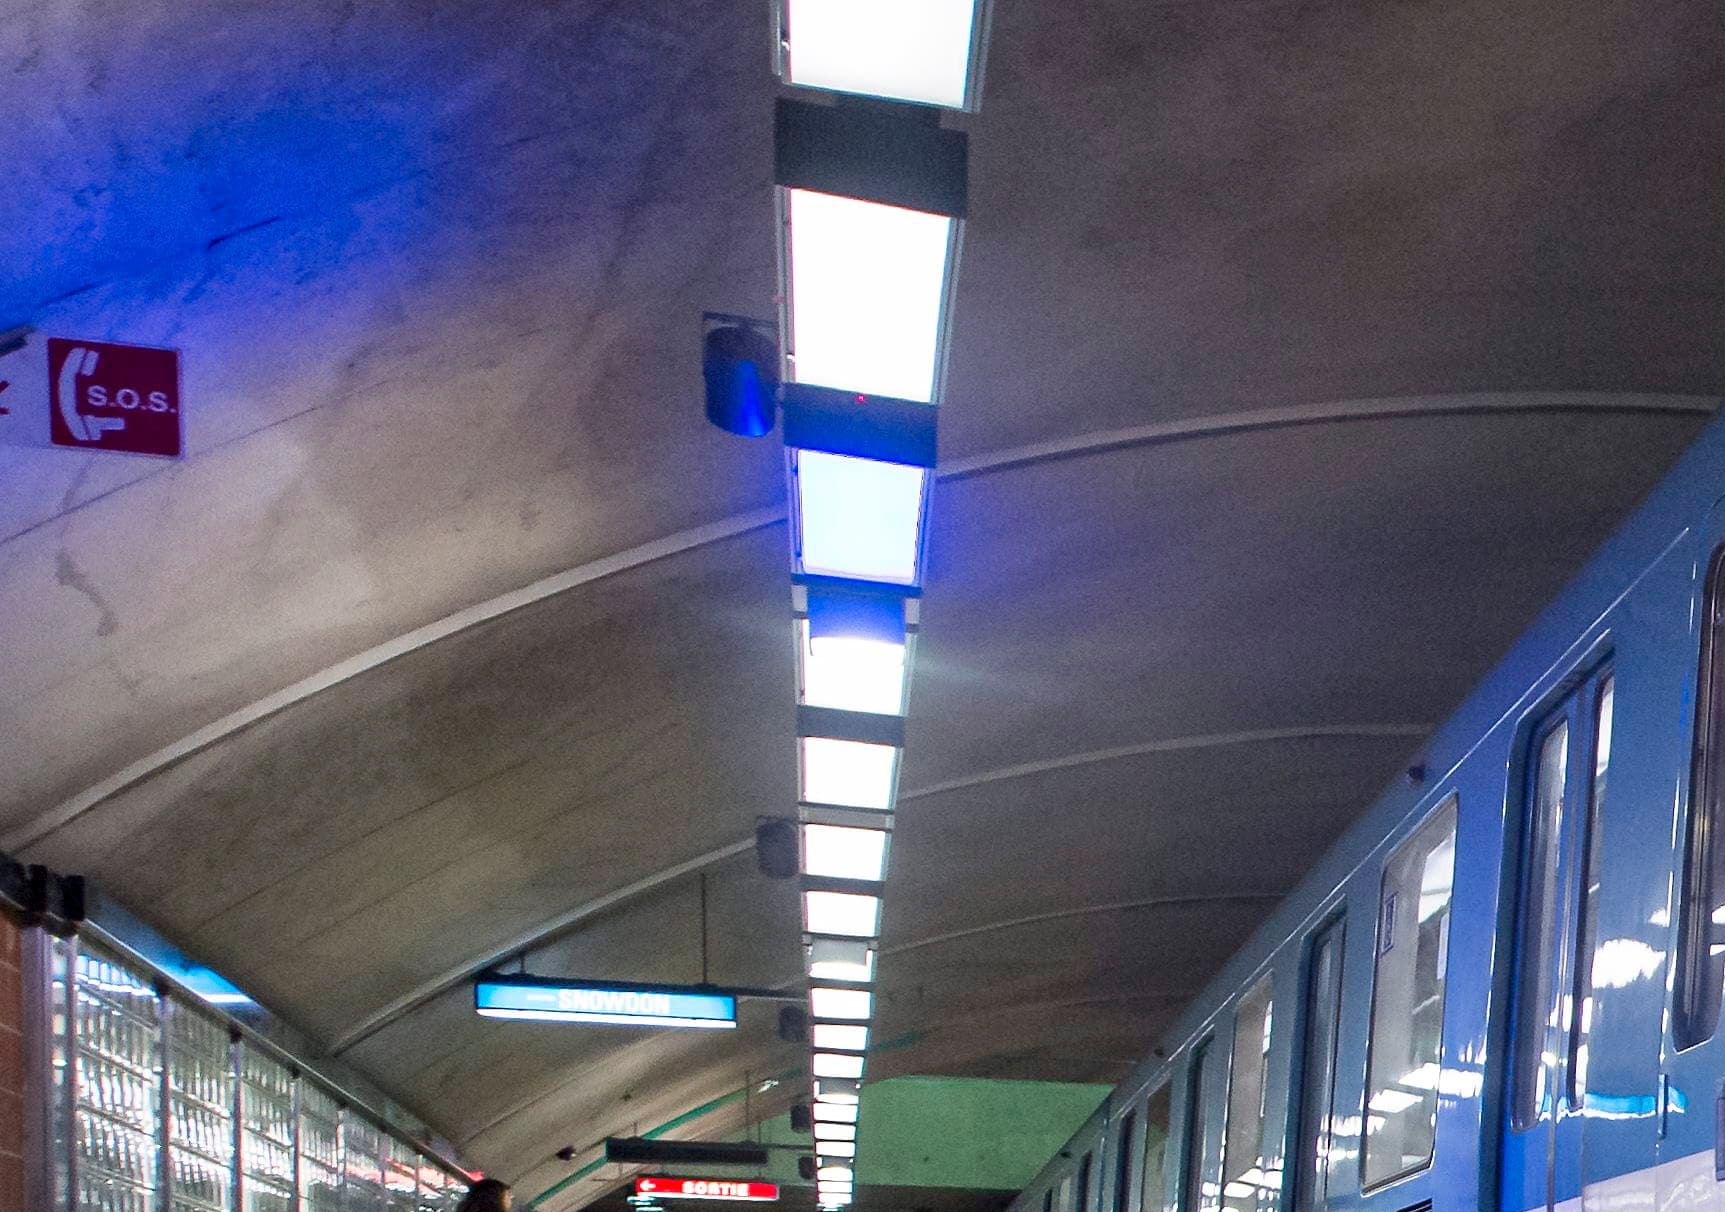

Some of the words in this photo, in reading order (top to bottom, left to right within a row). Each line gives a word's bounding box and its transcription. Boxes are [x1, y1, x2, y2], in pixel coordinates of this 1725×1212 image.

[87, 384, 178, 414] S.O.S.
[556, 988, 671, 1016] SNOWDON
[682, 1180, 750, 1198] SORTIE
